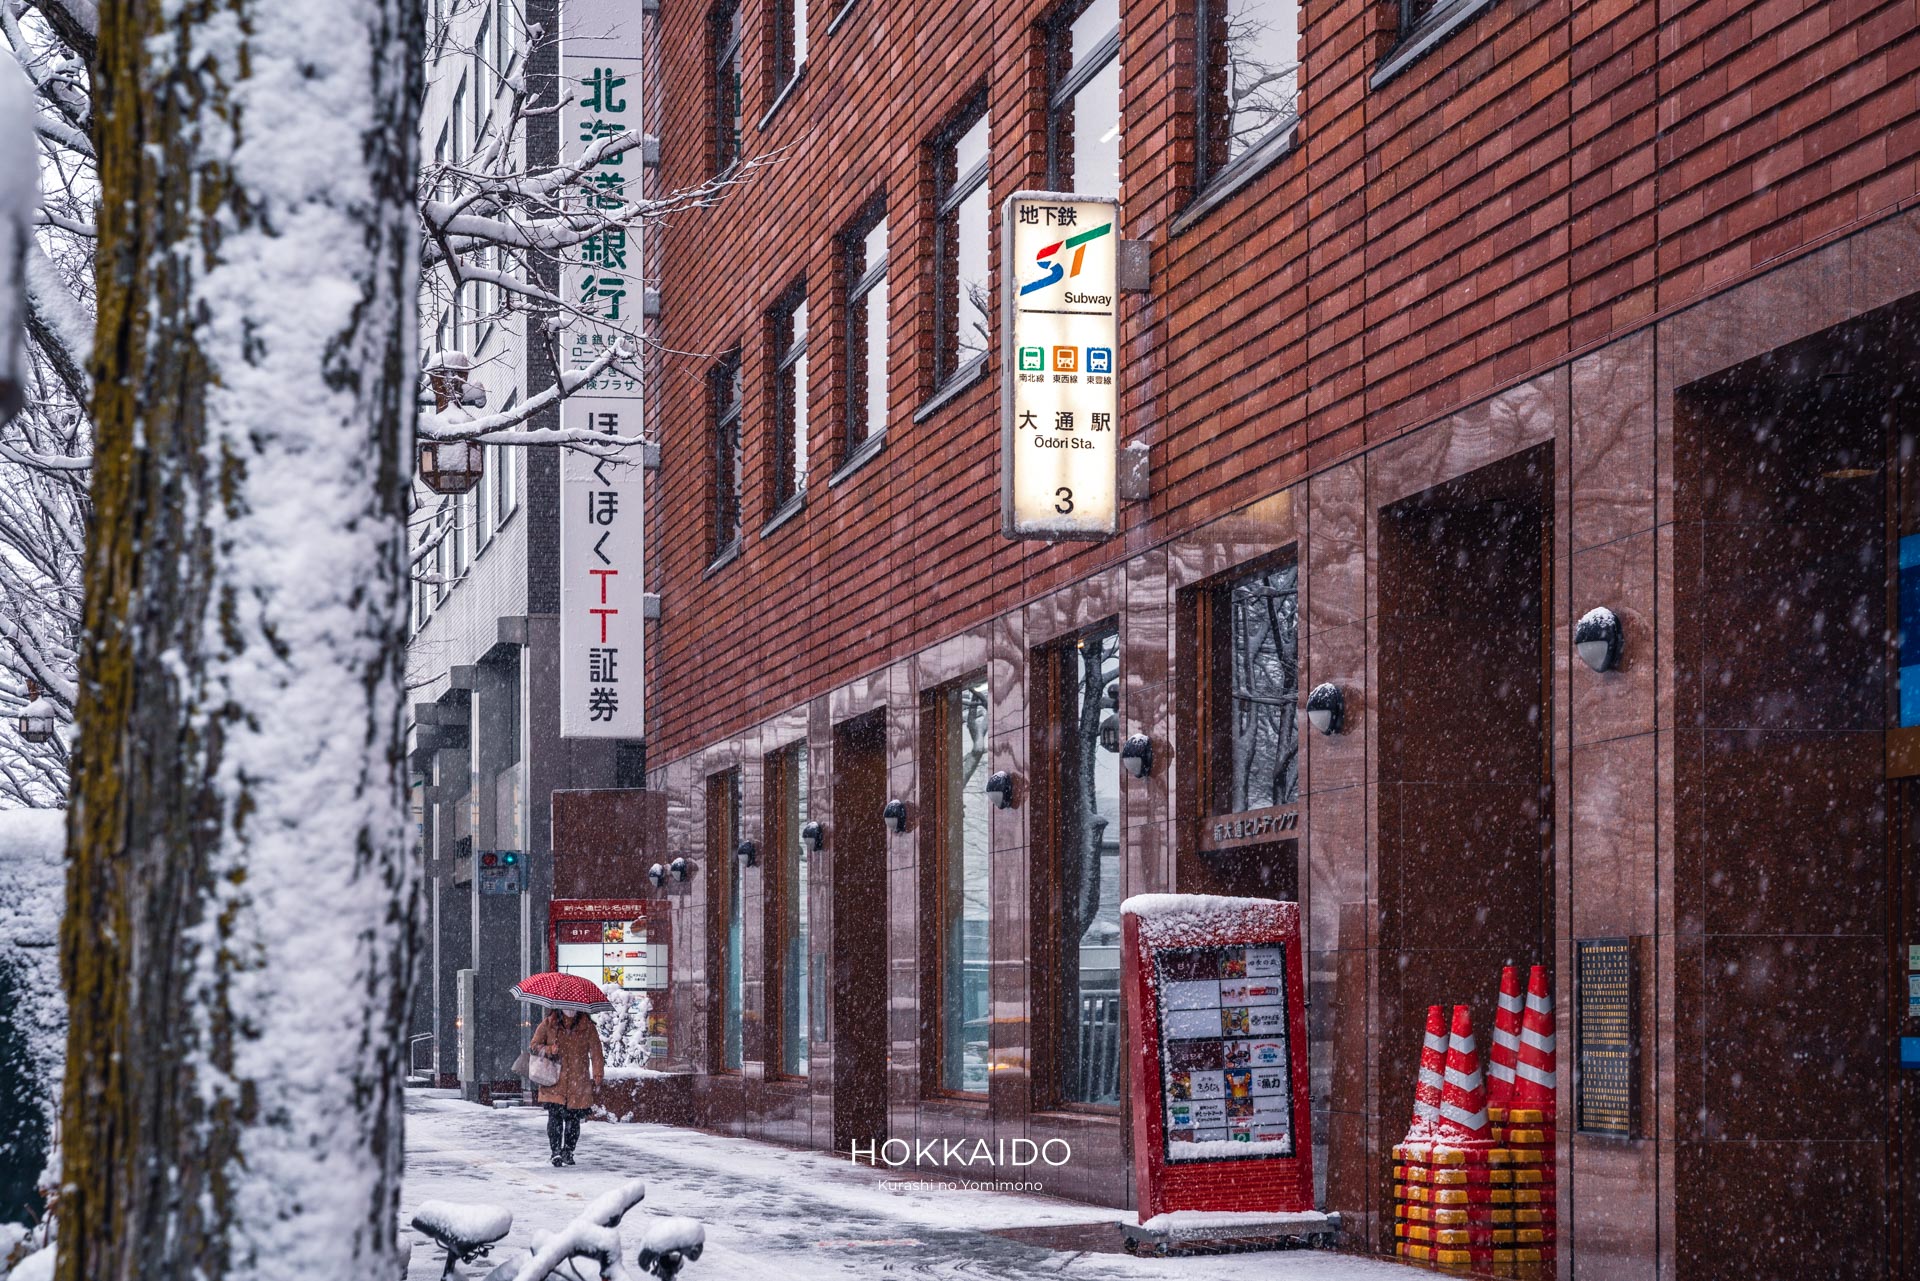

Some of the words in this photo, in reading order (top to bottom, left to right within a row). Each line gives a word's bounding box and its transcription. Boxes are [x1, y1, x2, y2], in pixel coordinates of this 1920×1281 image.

[1019, 205, 1077, 226] 地下鉄
[1064, 292, 1112, 306] Subway
[1018, 373, 1045, 383] 南北線
[1052, 374, 1079, 384] 東西線
[1086, 375, 1112, 385] 東豊線
[1018, 410, 1111, 432] 大通駅
[1071, 437, 1095, 450] Sta.
[1054, 486, 1074, 515] 3
